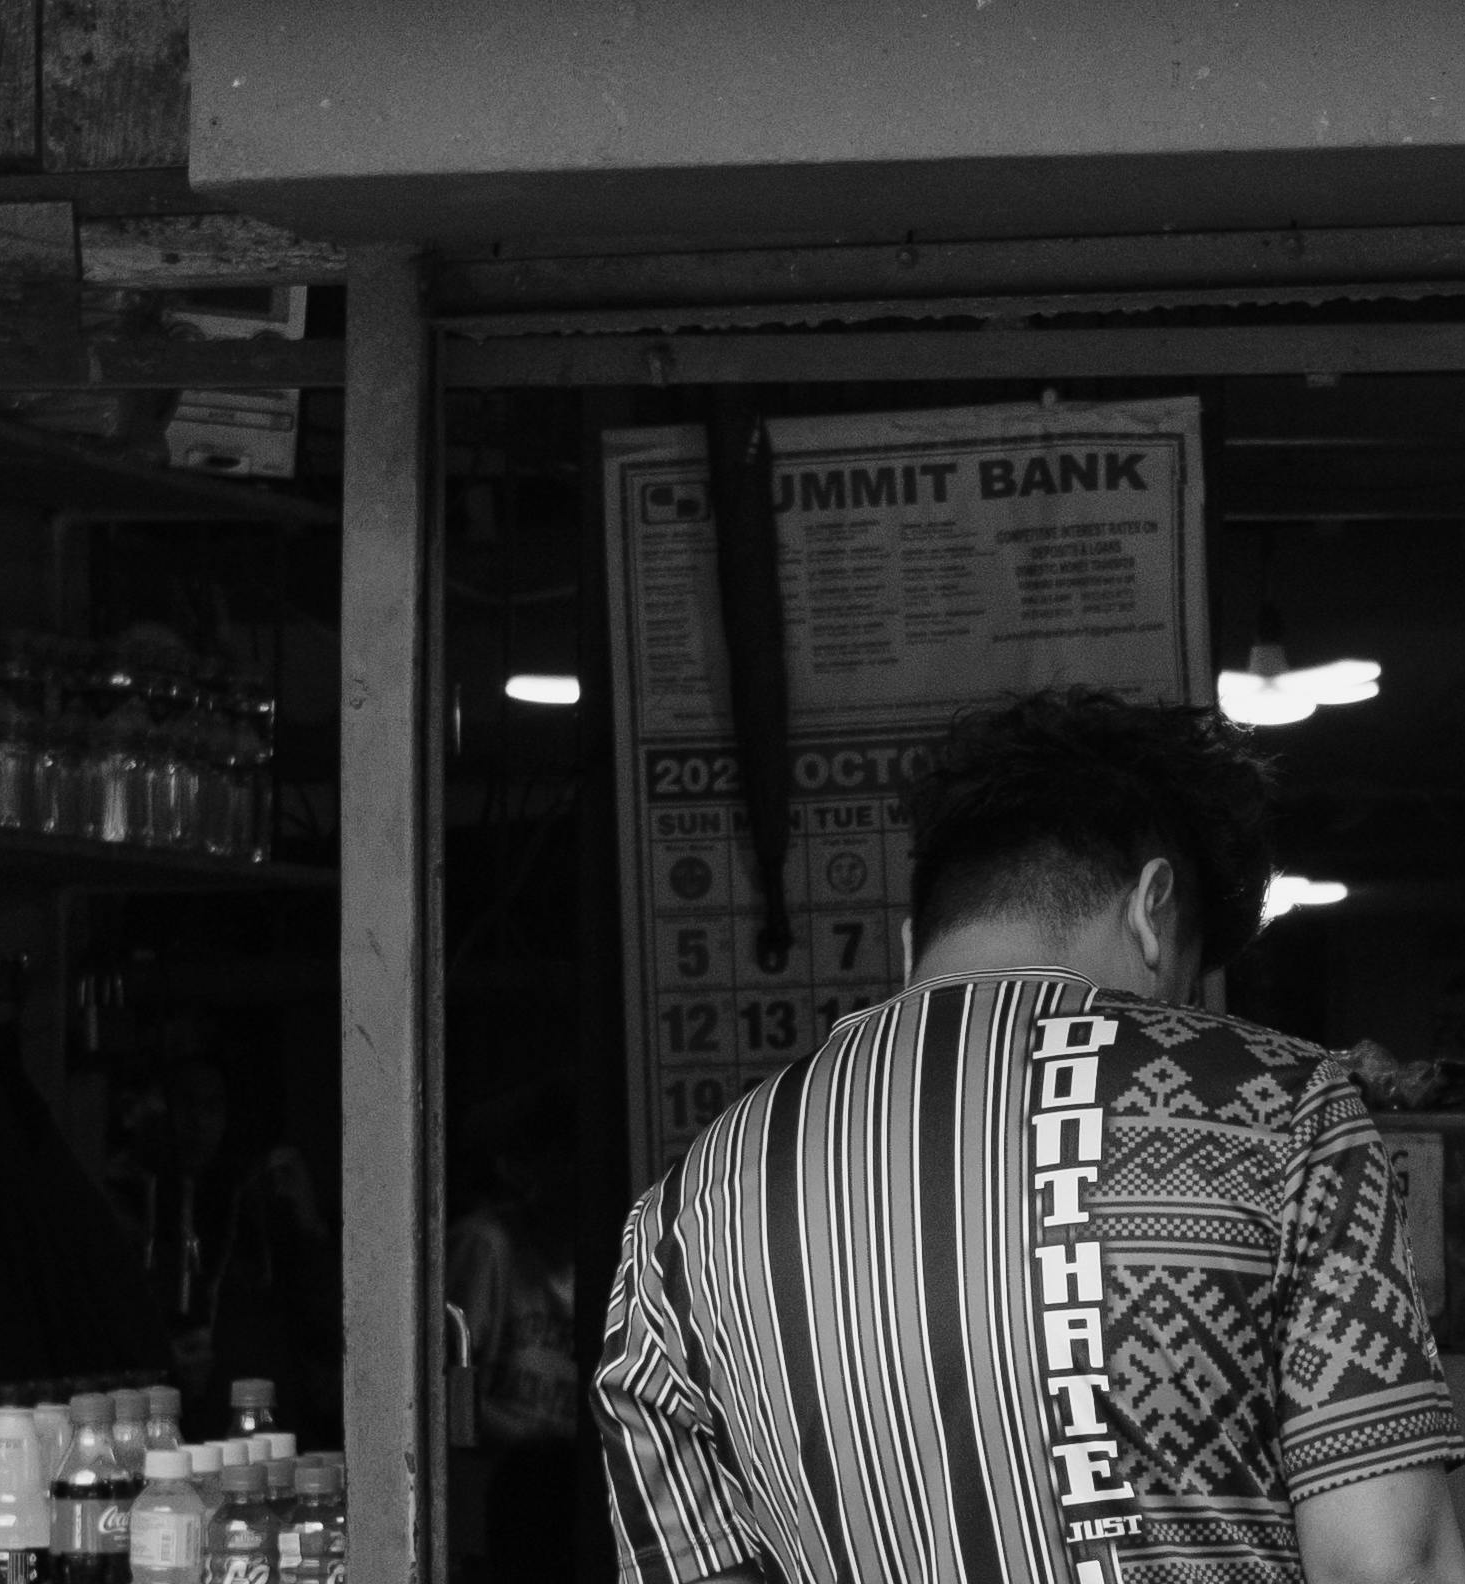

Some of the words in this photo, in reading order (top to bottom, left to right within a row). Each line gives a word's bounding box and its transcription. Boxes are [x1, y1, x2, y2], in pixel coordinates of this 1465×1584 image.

[774, 462, 957, 515] UMMIT
[978, 452, 1148, 501] BANK
[653, 757, 741, 795] 202
[795, 745, 937, 789] OCTO
[657, 811, 721, 836] SUN
[814, 805, 874, 829] TUE
[676, 929, 710, 979] 5
[832, 921, 865, 971] 7
[661, 1003, 720, 1054] 12
[740, 999, 798, 1050] 13
[1066, 1514, 1143, 1543] JUST
